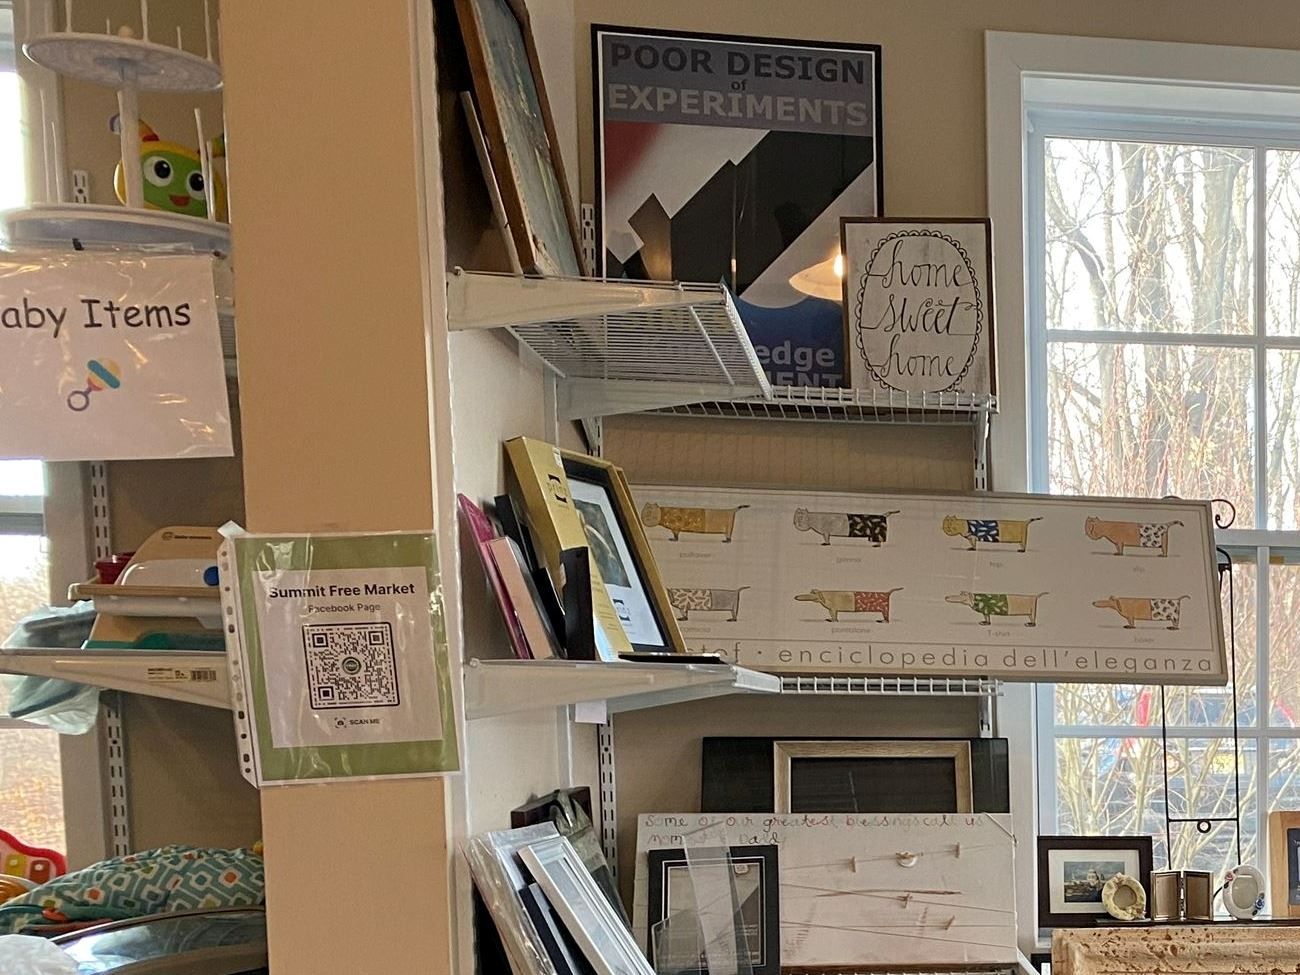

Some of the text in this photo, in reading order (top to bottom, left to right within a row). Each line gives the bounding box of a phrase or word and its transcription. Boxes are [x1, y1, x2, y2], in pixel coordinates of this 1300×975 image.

[611, 42, 865, 85] POOR DESIGN
[731, 79, 747, 92] of
[608, 83, 870, 127] EXPERIMENTS
[874, 239, 968, 289] home
[81, 298, 192, 329] Items
[872, 293, 972, 336] sweet
[875, 333, 958, 378] home
[269, 583, 416, 599] Summit Free Market
[308, 603, 381, 613] Facebook Page
[778, 645, 988, 669] enciclopedia
[1003, 648, 1212, 674] dell'eleganza
